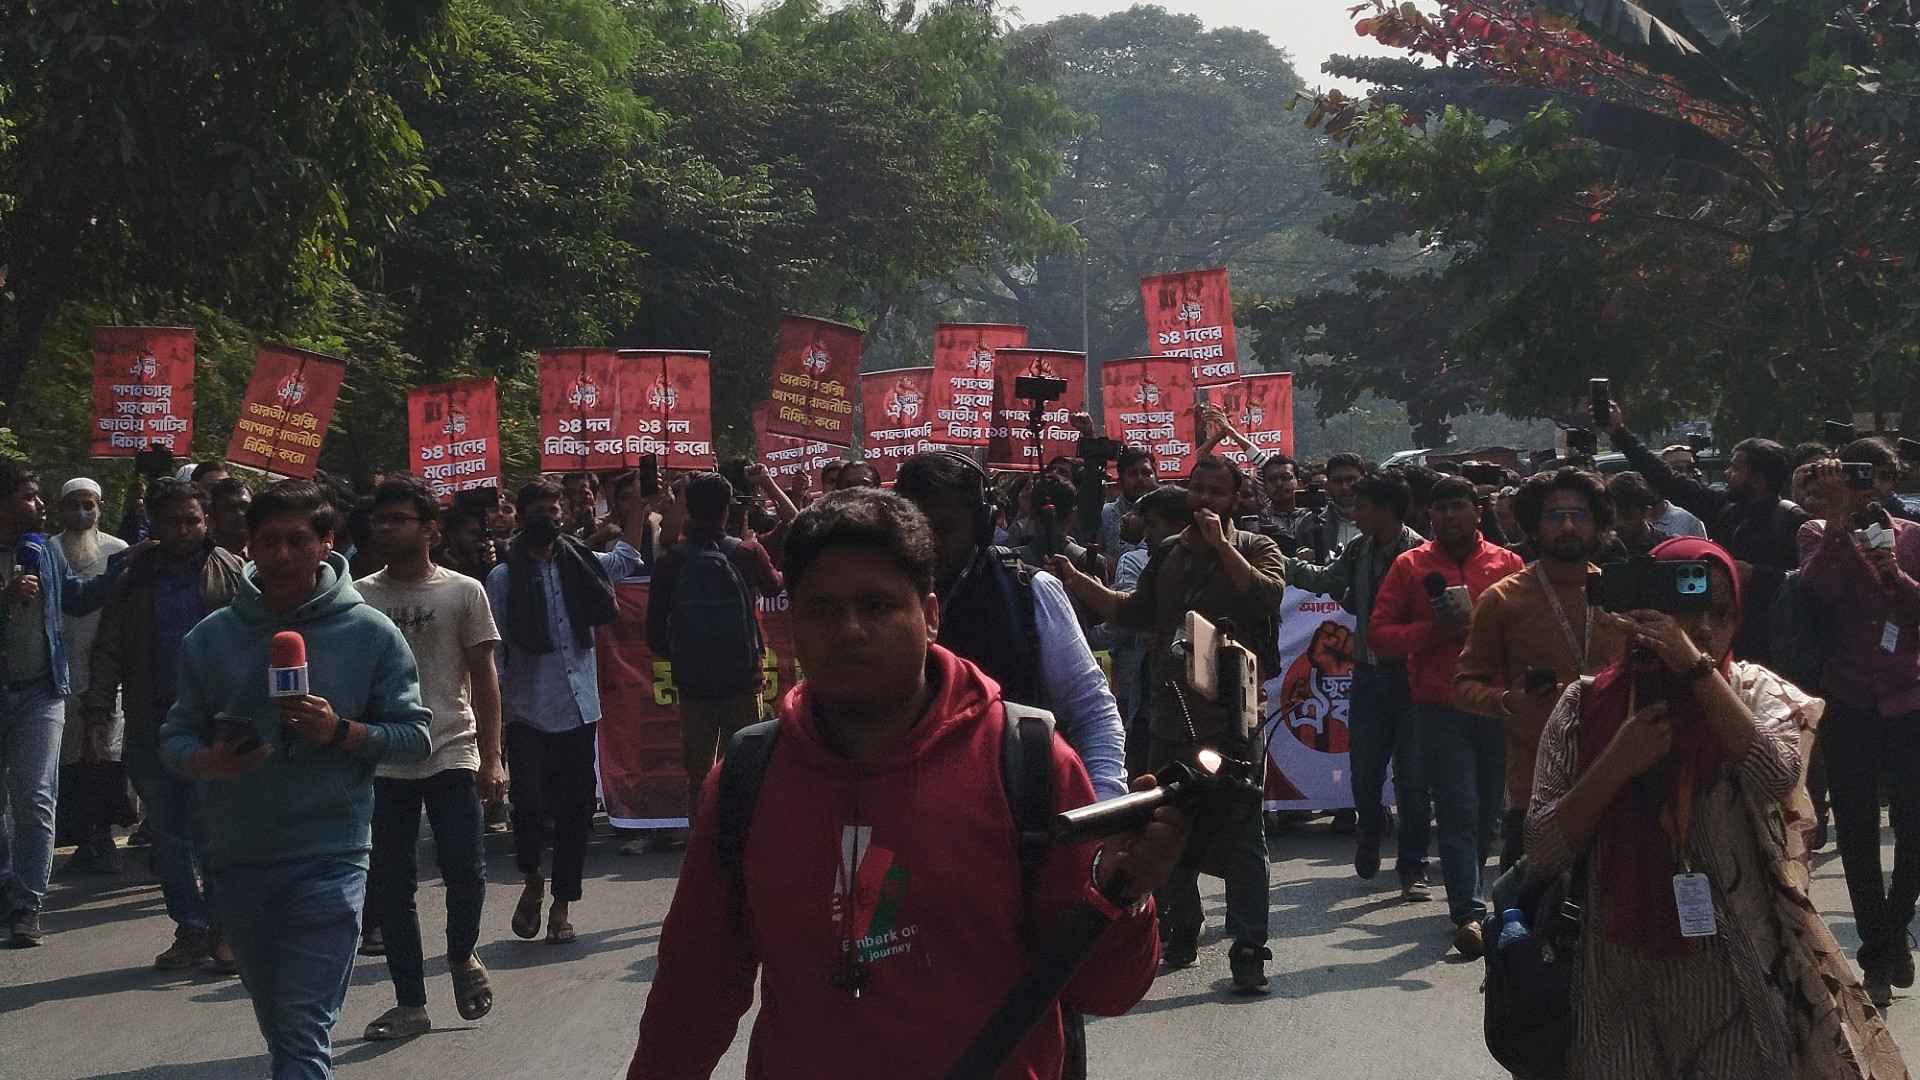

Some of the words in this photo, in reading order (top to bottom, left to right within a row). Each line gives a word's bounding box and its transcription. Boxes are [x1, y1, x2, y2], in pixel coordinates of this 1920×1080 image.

[1159, 331, 1180, 345] ১৪
[1184, 326, 1222, 342] দলের
[1201, 362, 1235, 377] করো
[113, 384, 172, 398] গণহত্যার
[772, 389, 807, 406] জাপার
[117, 398, 171, 415] সহযোগী
[937, 406, 979, 422] জাতীয়
[99, 415, 144, 432] জাতীয়
[239, 418, 275, 437] জাপার
[559, 418, 582, 433] ১৪
[585, 418, 611, 432] দল
[639, 419, 662, 433] ১৪
[667, 420, 690, 433] দল
[814, 415, 841, 431] করো
[948, 421, 981, 438] বিচার
[111, 432, 147, 449] বিচার
[1048, 426, 1081, 442] বিচার
[421, 445, 444, 460] ১৪
[447, 438, 487, 456] দলের
[544, 436, 591, 455] নিষিদ্ধ
[674, 440, 710, 456] করো
[864, 448, 881, 459] ১৪
[884, 444, 914, 457] দলের
[278, 448, 307, 464] করো
[423, 457, 487, 479] মনোনয়ন
[1160, 458, 1181, 471] চাই
[868, 942, 912, 963] journey
